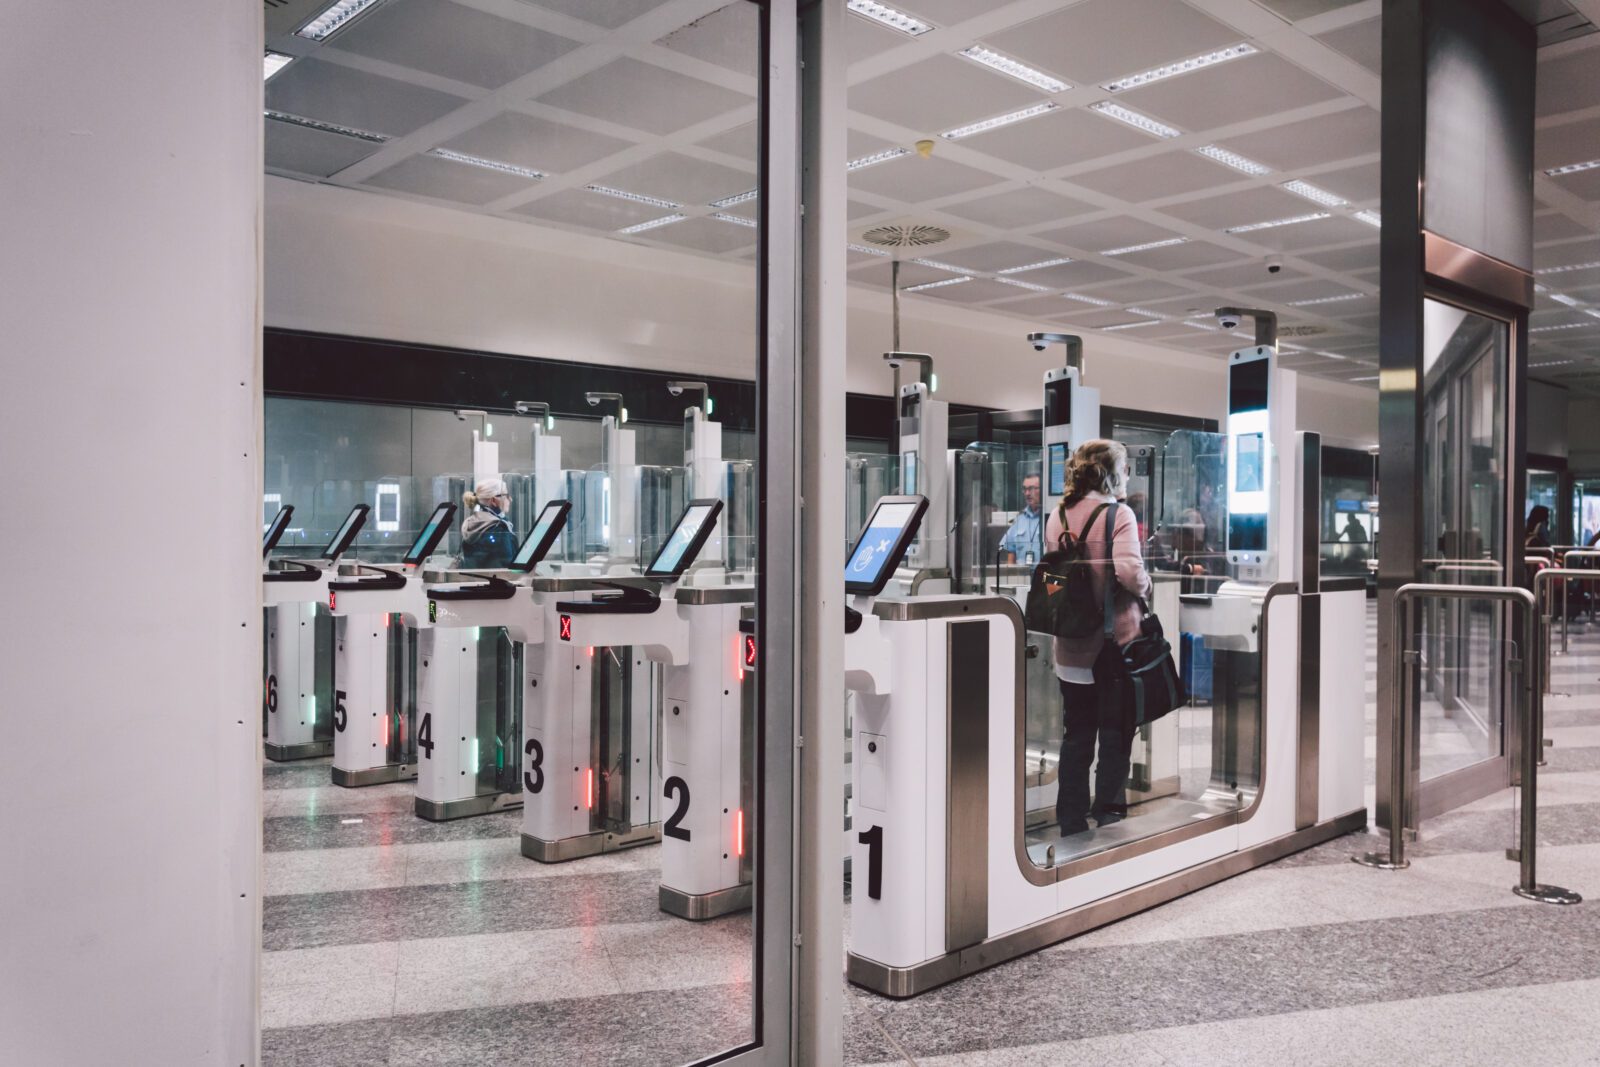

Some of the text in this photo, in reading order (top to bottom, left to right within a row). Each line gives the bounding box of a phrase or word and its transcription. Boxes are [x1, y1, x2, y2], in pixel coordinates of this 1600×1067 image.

[268, 674, 278, 713] 6
[335, 689, 347, 733] 5
[417, 713, 435, 760] 4
[523, 738, 545, 793] 3
[662, 775, 691, 842] 2
[858, 824, 883, 901] 1
